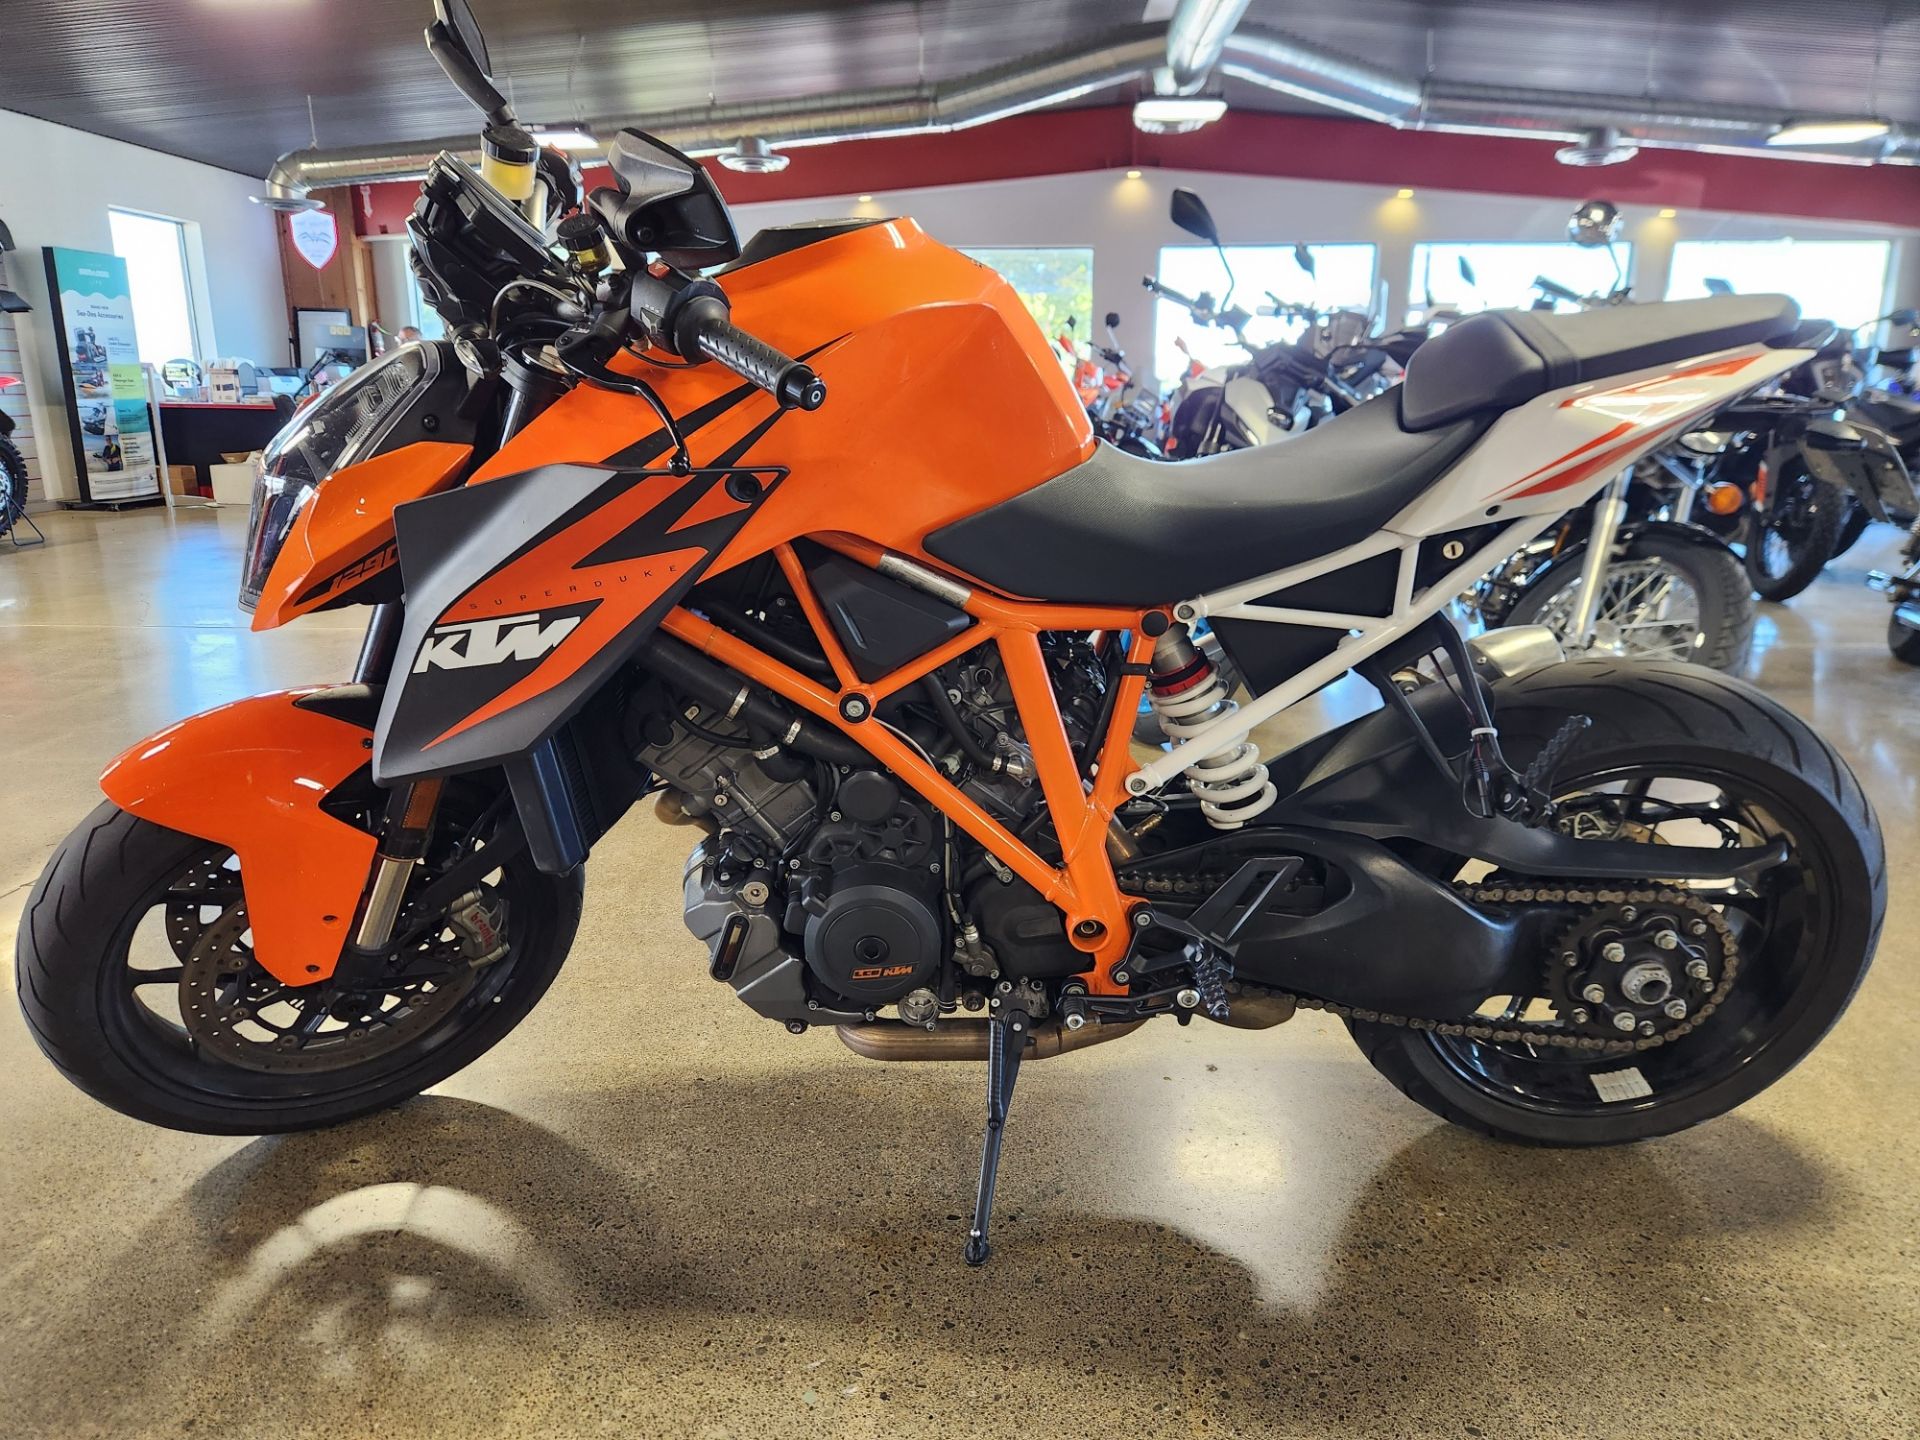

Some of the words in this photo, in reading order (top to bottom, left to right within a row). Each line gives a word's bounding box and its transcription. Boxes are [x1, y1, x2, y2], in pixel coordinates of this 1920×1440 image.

[470, 565, 677, 610] SUPERDUKE
[412, 613, 581, 674] KTM
[883, 965, 913, 977] KTM
